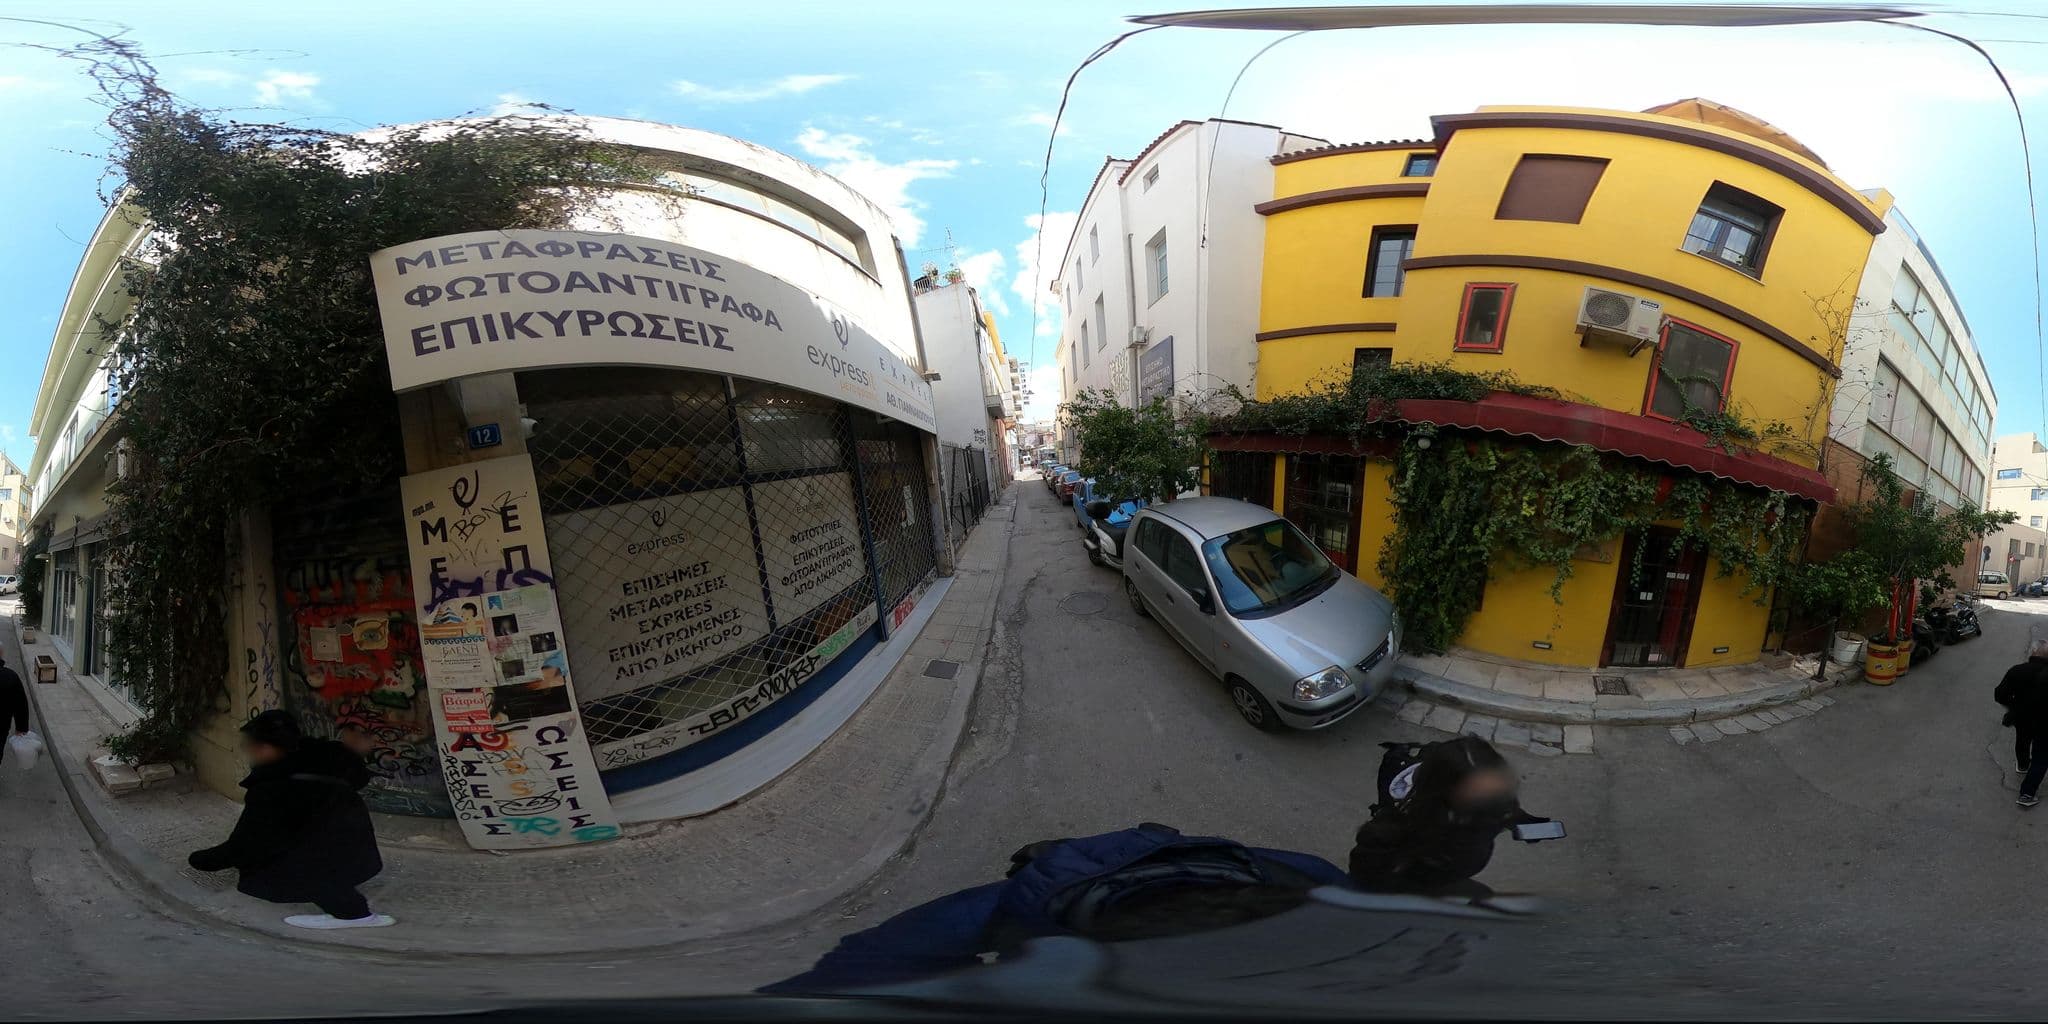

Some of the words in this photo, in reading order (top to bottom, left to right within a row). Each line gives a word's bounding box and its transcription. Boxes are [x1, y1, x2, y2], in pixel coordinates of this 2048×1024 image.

[395, 238, 727, 283] ΜΕΤΑΦΡΑΣΕΙΣ
[403, 270, 783, 332] ΦΩΤΟΑΝΤΙΓΡΑΦΑ
[411, 309, 734, 357] ΕΠΙΚΥΡΩΣΕΙΣ
[475, 426, 493, 444] 12
[608, 575, 729, 622] ΜΕΤΑΦΡΑΣΕΙΣ
[622, 560, 712, 597] ΕΠΙΣΗΜΕΣ
[794, 579, 815, 598] ΑΠΟ
[608, 607, 742, 663] ΕΠΙΚΥΡΩΜΕΝΕΣ
[637, 600, 713, 635] EXPRESS
[615, 657, 659, 681] ΑΠΟ
[662, 624, 743, 666] ΔΙΚΗΓΟΡΟ
